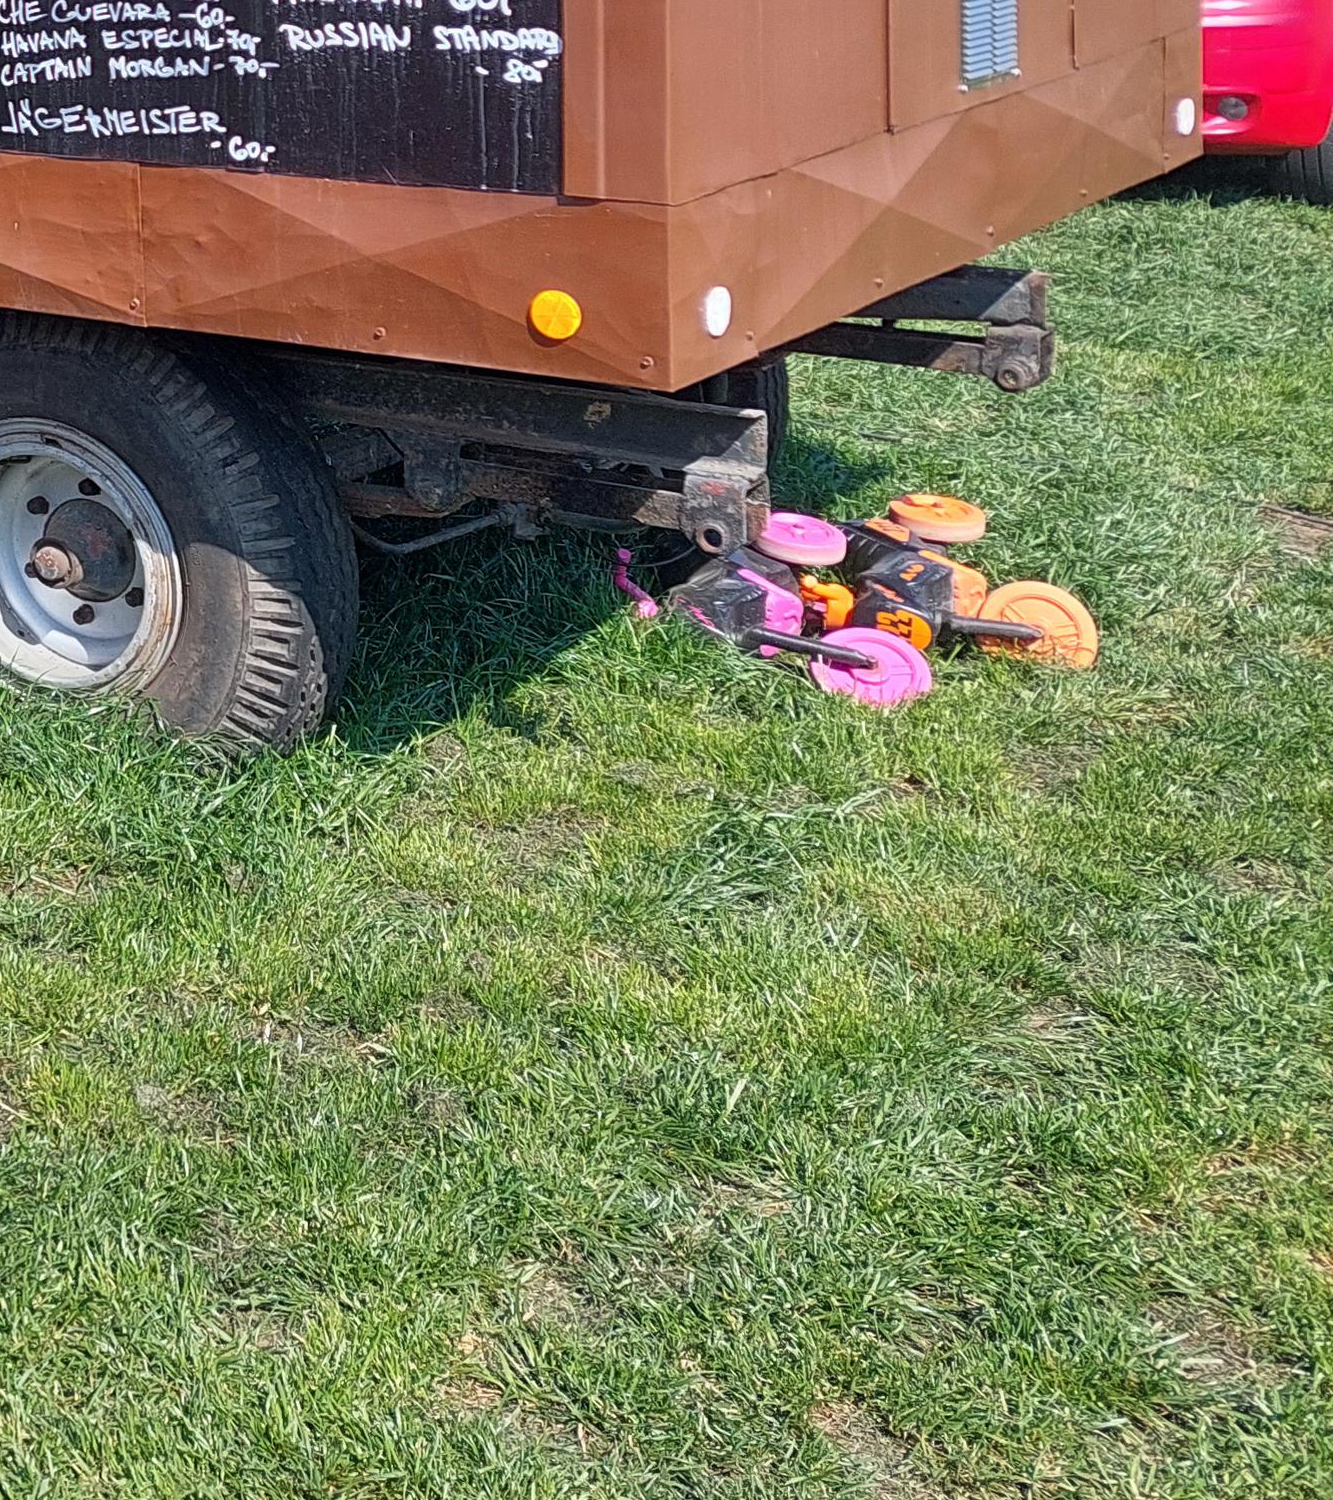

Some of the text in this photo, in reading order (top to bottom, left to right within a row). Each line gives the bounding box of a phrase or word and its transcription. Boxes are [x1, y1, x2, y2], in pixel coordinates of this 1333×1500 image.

[1, 27, 221, 58] HAVANA ESPECIAL
[279, 22, 411, 51] RUSSIAN
[0, 56, 92, 86] CAPTAIN
[108, 56, 210, 80] MORGAN
